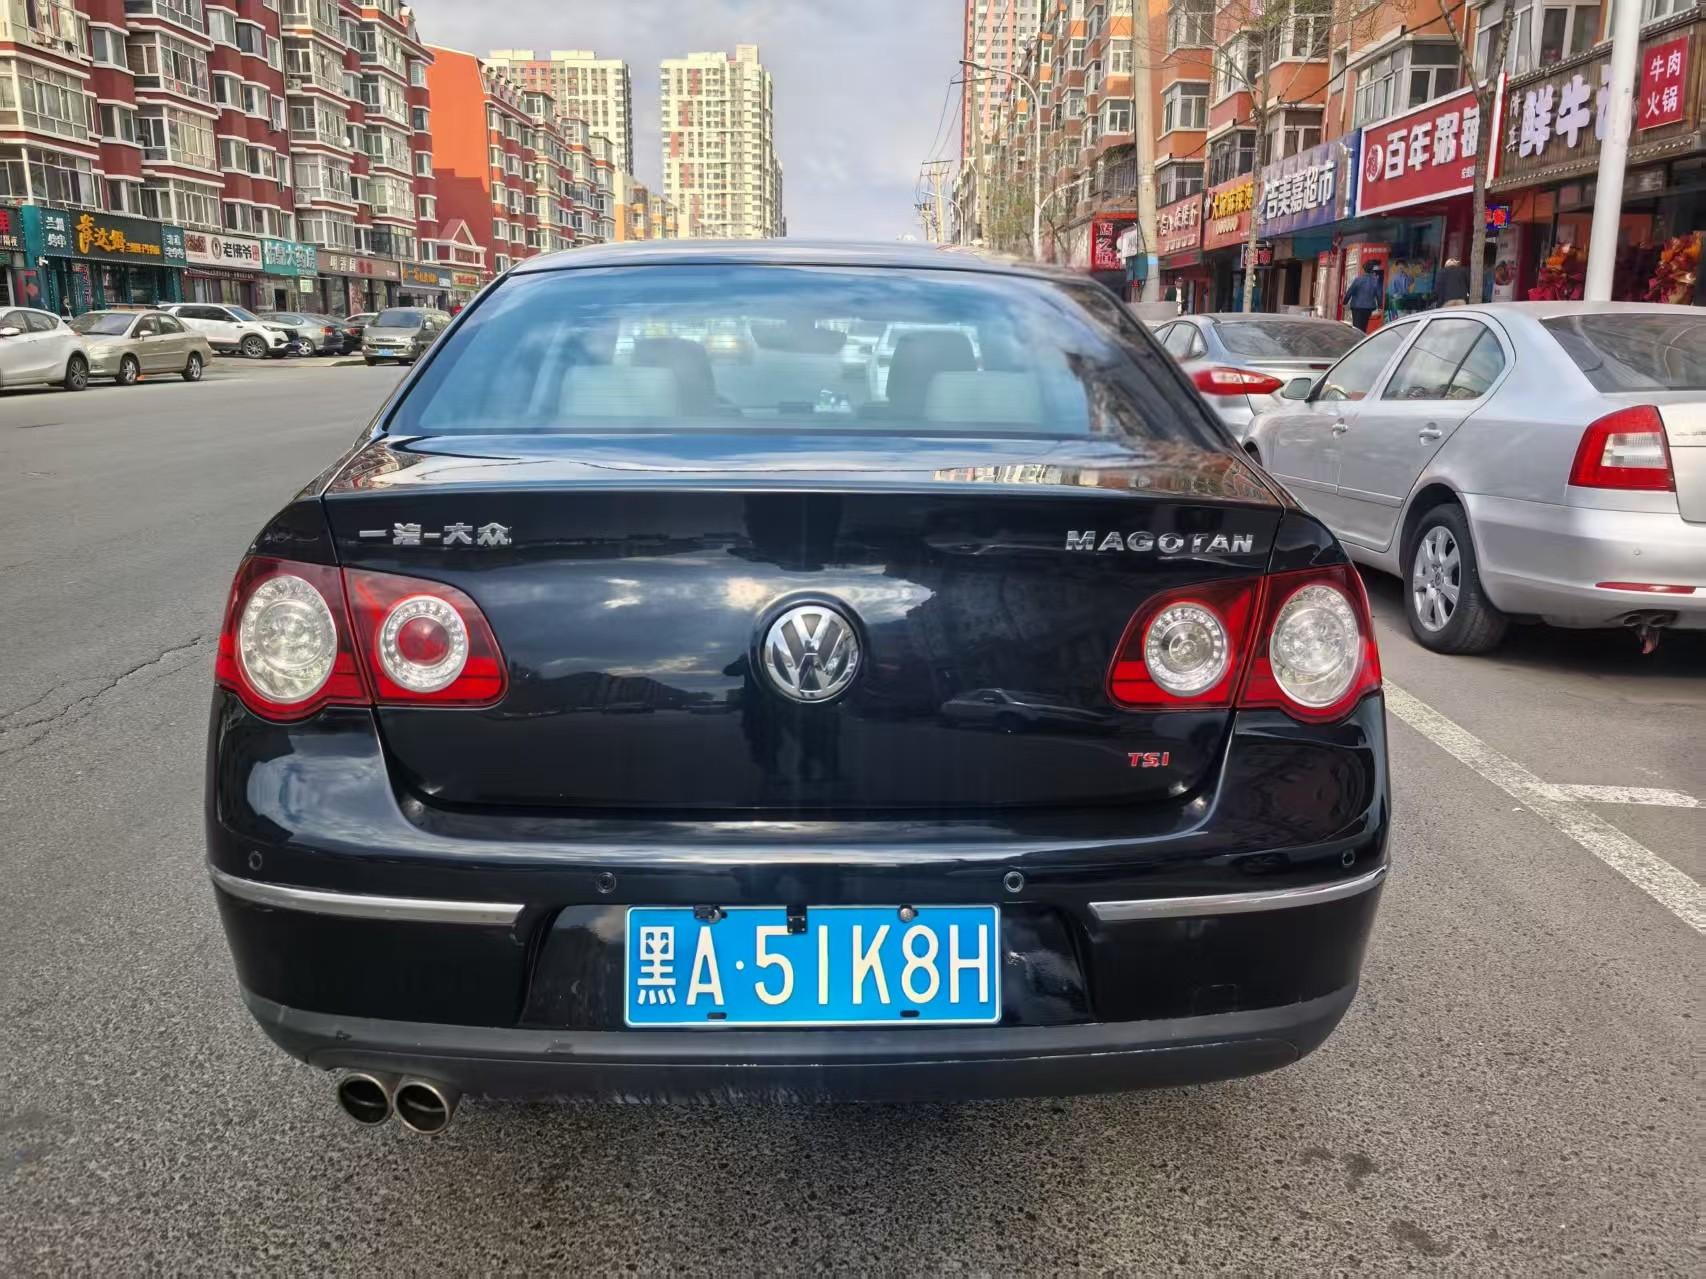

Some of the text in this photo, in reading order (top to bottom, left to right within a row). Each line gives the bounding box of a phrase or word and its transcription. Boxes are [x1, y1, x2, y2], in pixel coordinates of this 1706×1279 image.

[1649, 50, 1682, 82] 牛肉
[1645, 85, 1679, 119] 火锅
[1384, 104, 1480, 180] 百年粥铺
[222, 242, 252, 260] 老佛爷
[1064, 530, 1254, 553] MAGOTAN
[1127, 752, 1170, 768] TSI
